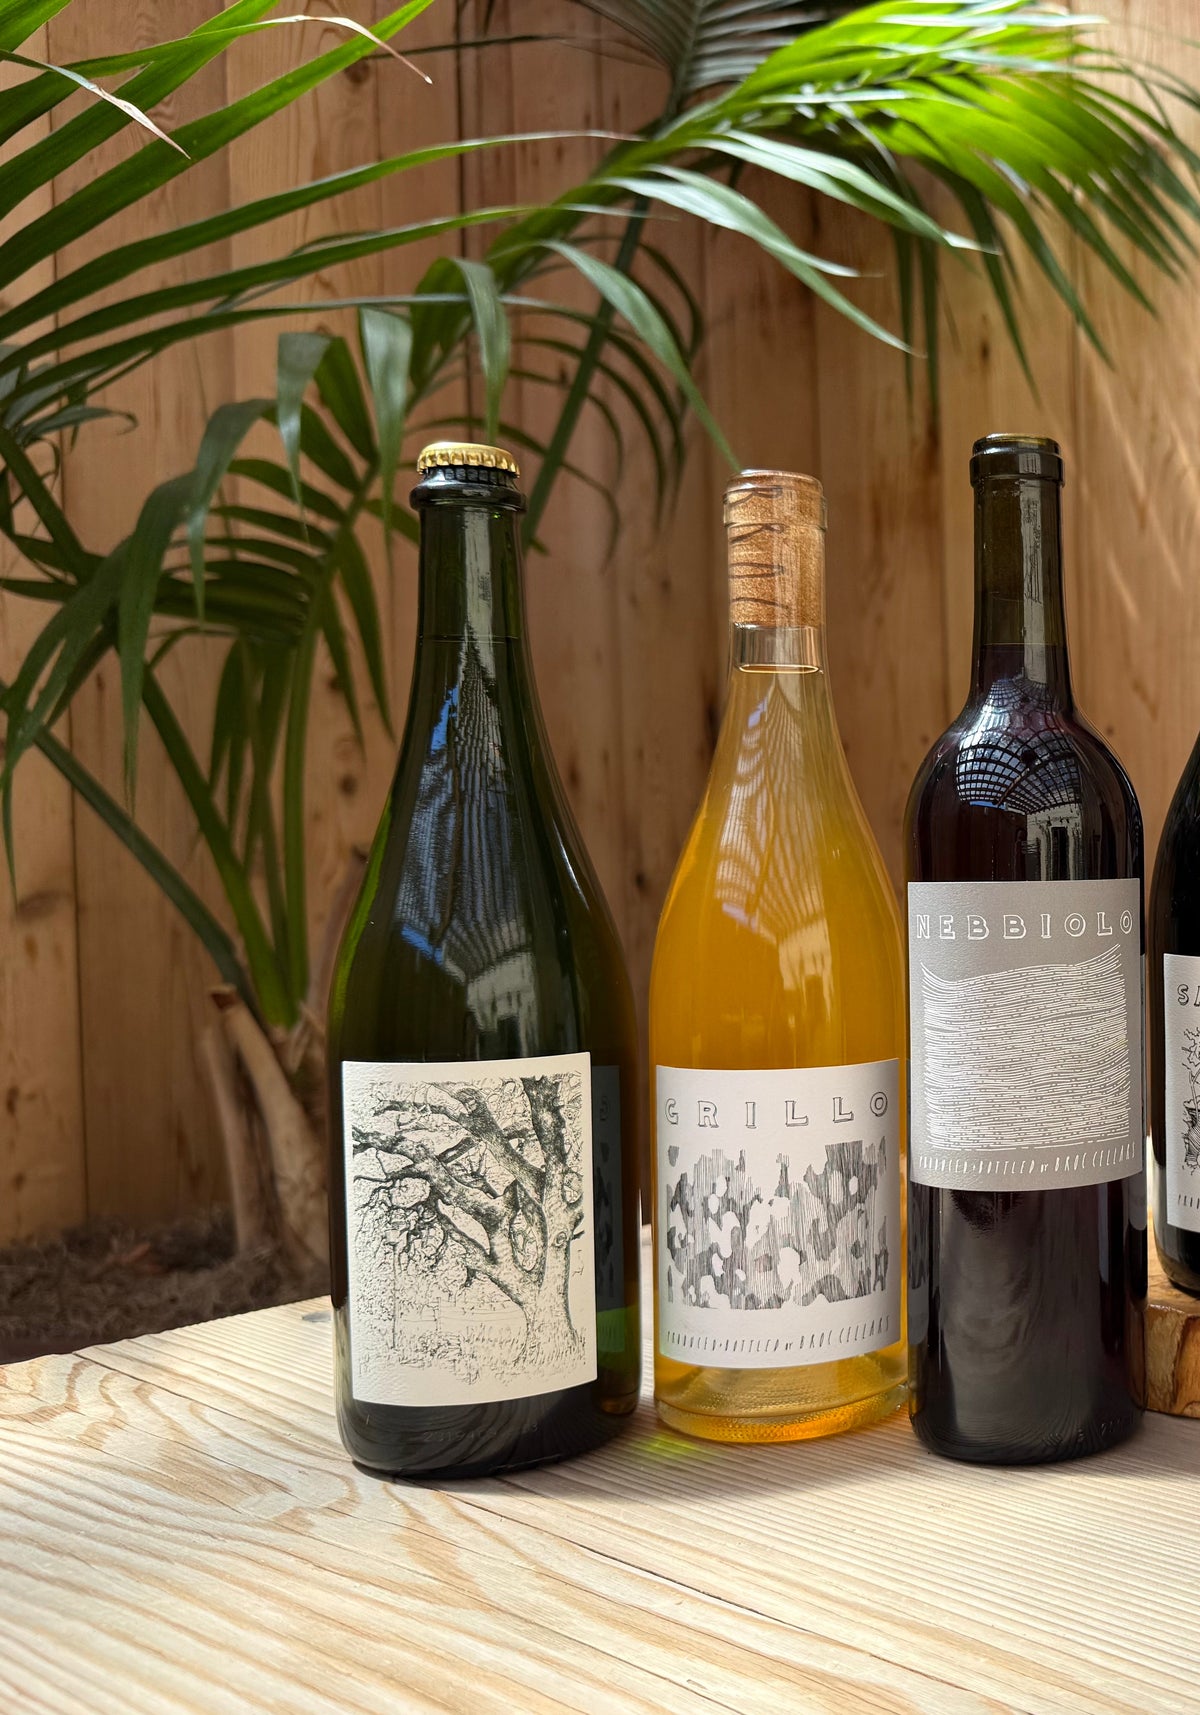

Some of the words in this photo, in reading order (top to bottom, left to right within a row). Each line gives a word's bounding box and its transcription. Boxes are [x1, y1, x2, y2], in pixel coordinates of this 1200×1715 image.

[915, 909, 1134, 941] NEBBIOLO
[664, 1091, 889, 1128] GRILLO
[1055, 1152, 1087, 1172] BROC
[1093, 1141, 1136, 1167] CELLARS
[799, 1329, 833, 1349] BROC
[839, 1315, 890, 1343] CELLARS
